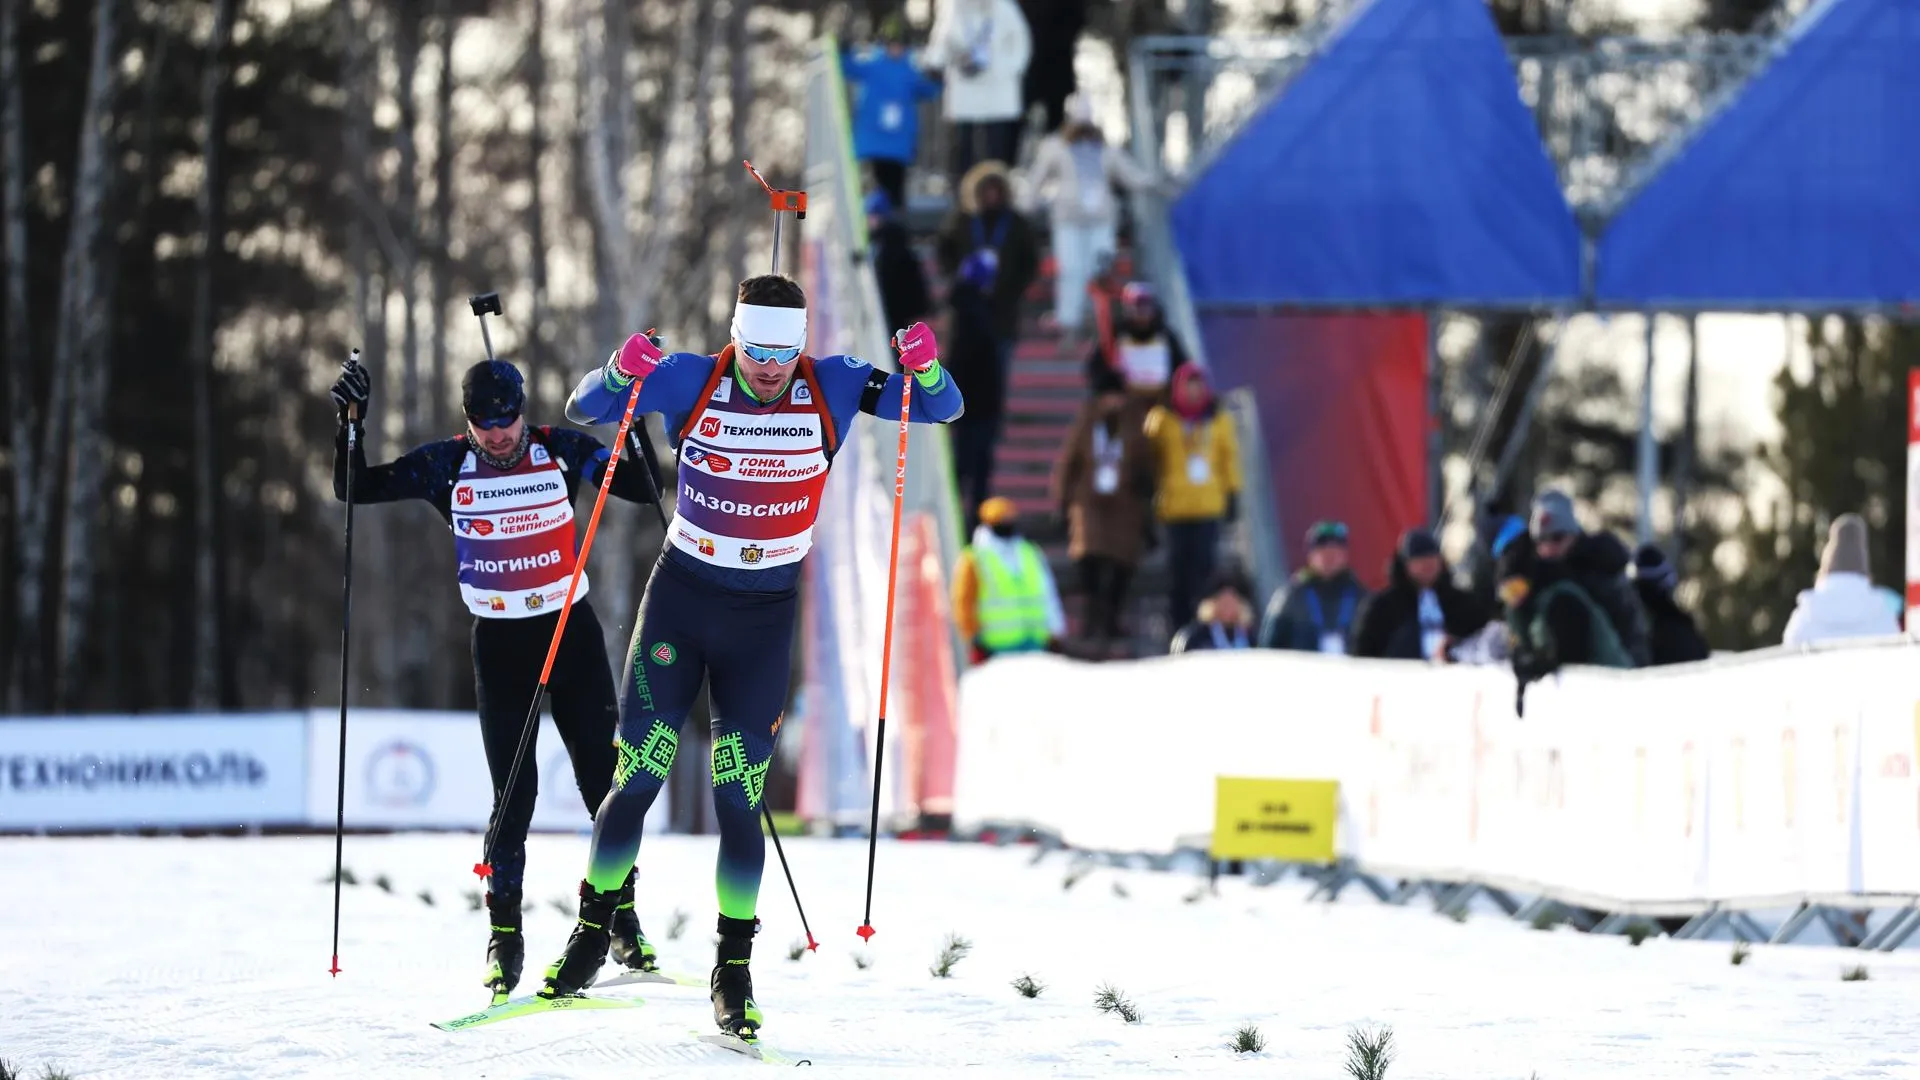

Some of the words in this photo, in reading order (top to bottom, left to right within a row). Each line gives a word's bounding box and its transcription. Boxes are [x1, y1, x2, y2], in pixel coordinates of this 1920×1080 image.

[723, 425, 813, 437] ТЕХНОНИКОЛЬ
[738, 464, 819, 478] ЧЕМПИОНОВ
[739, 458, 786, 468] ГОНКА
[476, 481, 559, 499] ТЕХНОНИКОЛЬ
[684, 484, 810, 517] ЛАЗОВСКИЙ
[500, 513, 540, 525] ГОНКА
[500, 512, 567, 535] ЧЕМПИОНОВ
[474, 549, 561, 573] ЛОГИНОВ
[0, 753, 267, 791] ЕХНОНИКОЛЬ
